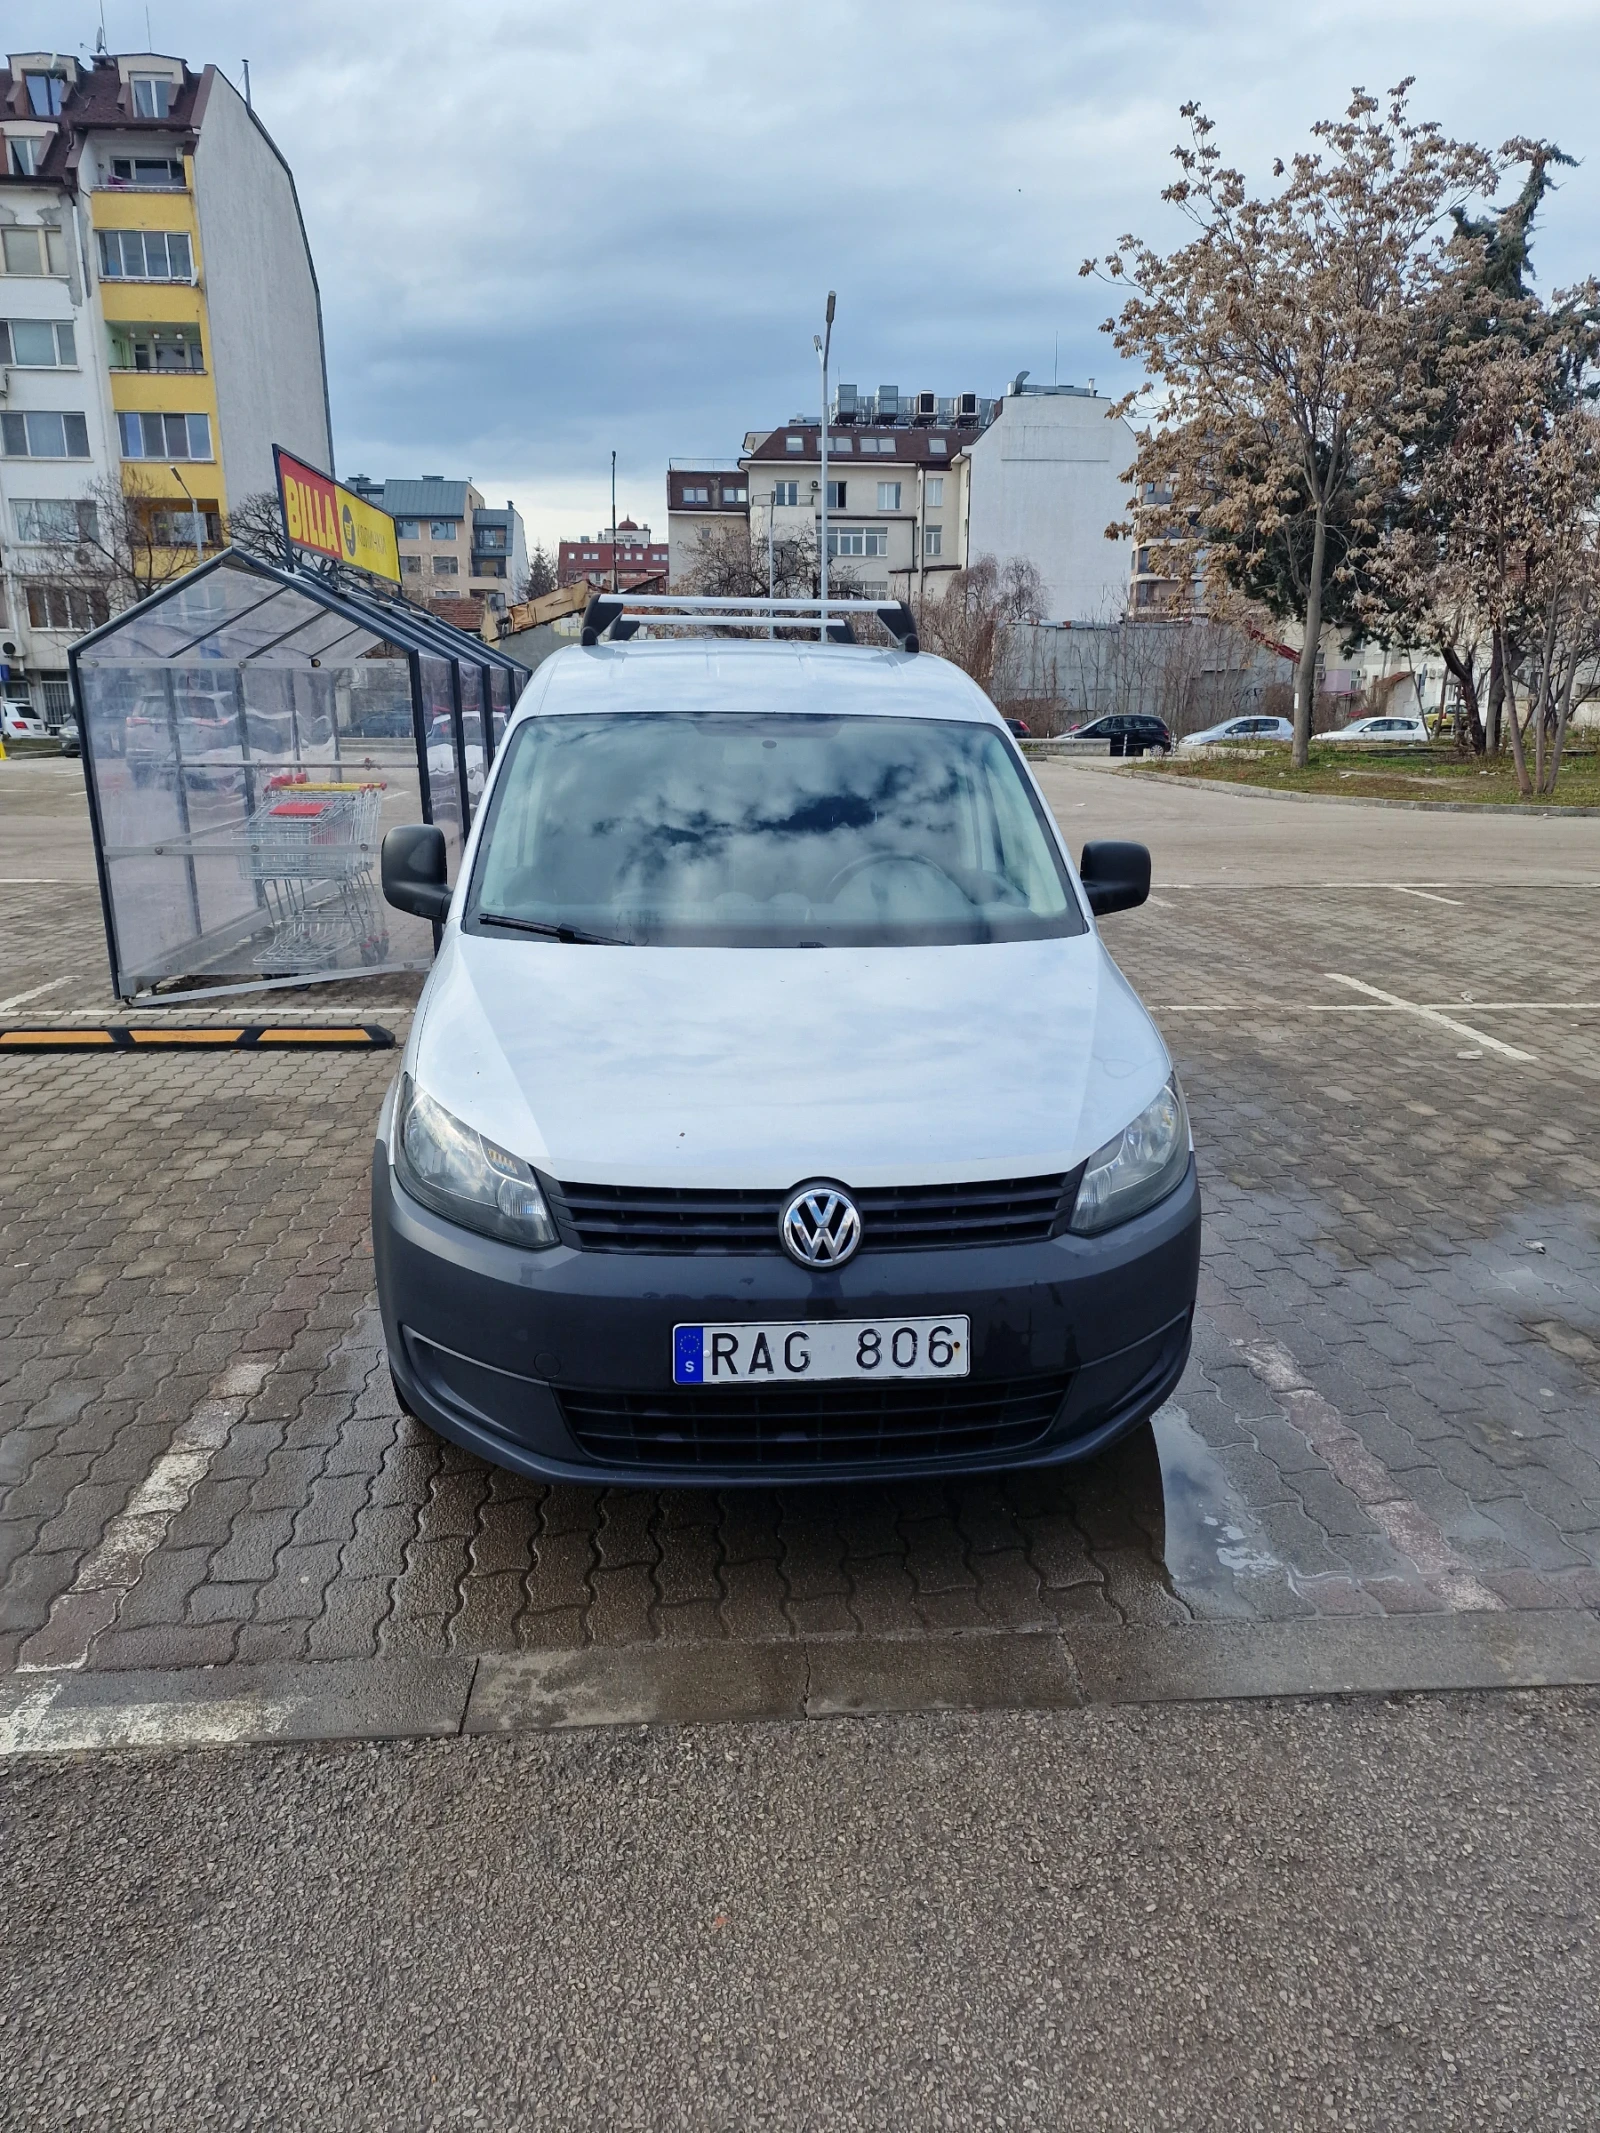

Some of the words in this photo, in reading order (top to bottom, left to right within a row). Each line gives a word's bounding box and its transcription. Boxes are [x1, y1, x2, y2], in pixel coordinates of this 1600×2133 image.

[284, 474, 340, 553] BILLA
[785, 1191, 859, 1264] VW
[685, 1361, 694, 1372] S
[711, 1331, 811, 1376] RAG
[856, 1325, 954, 1370] 806
